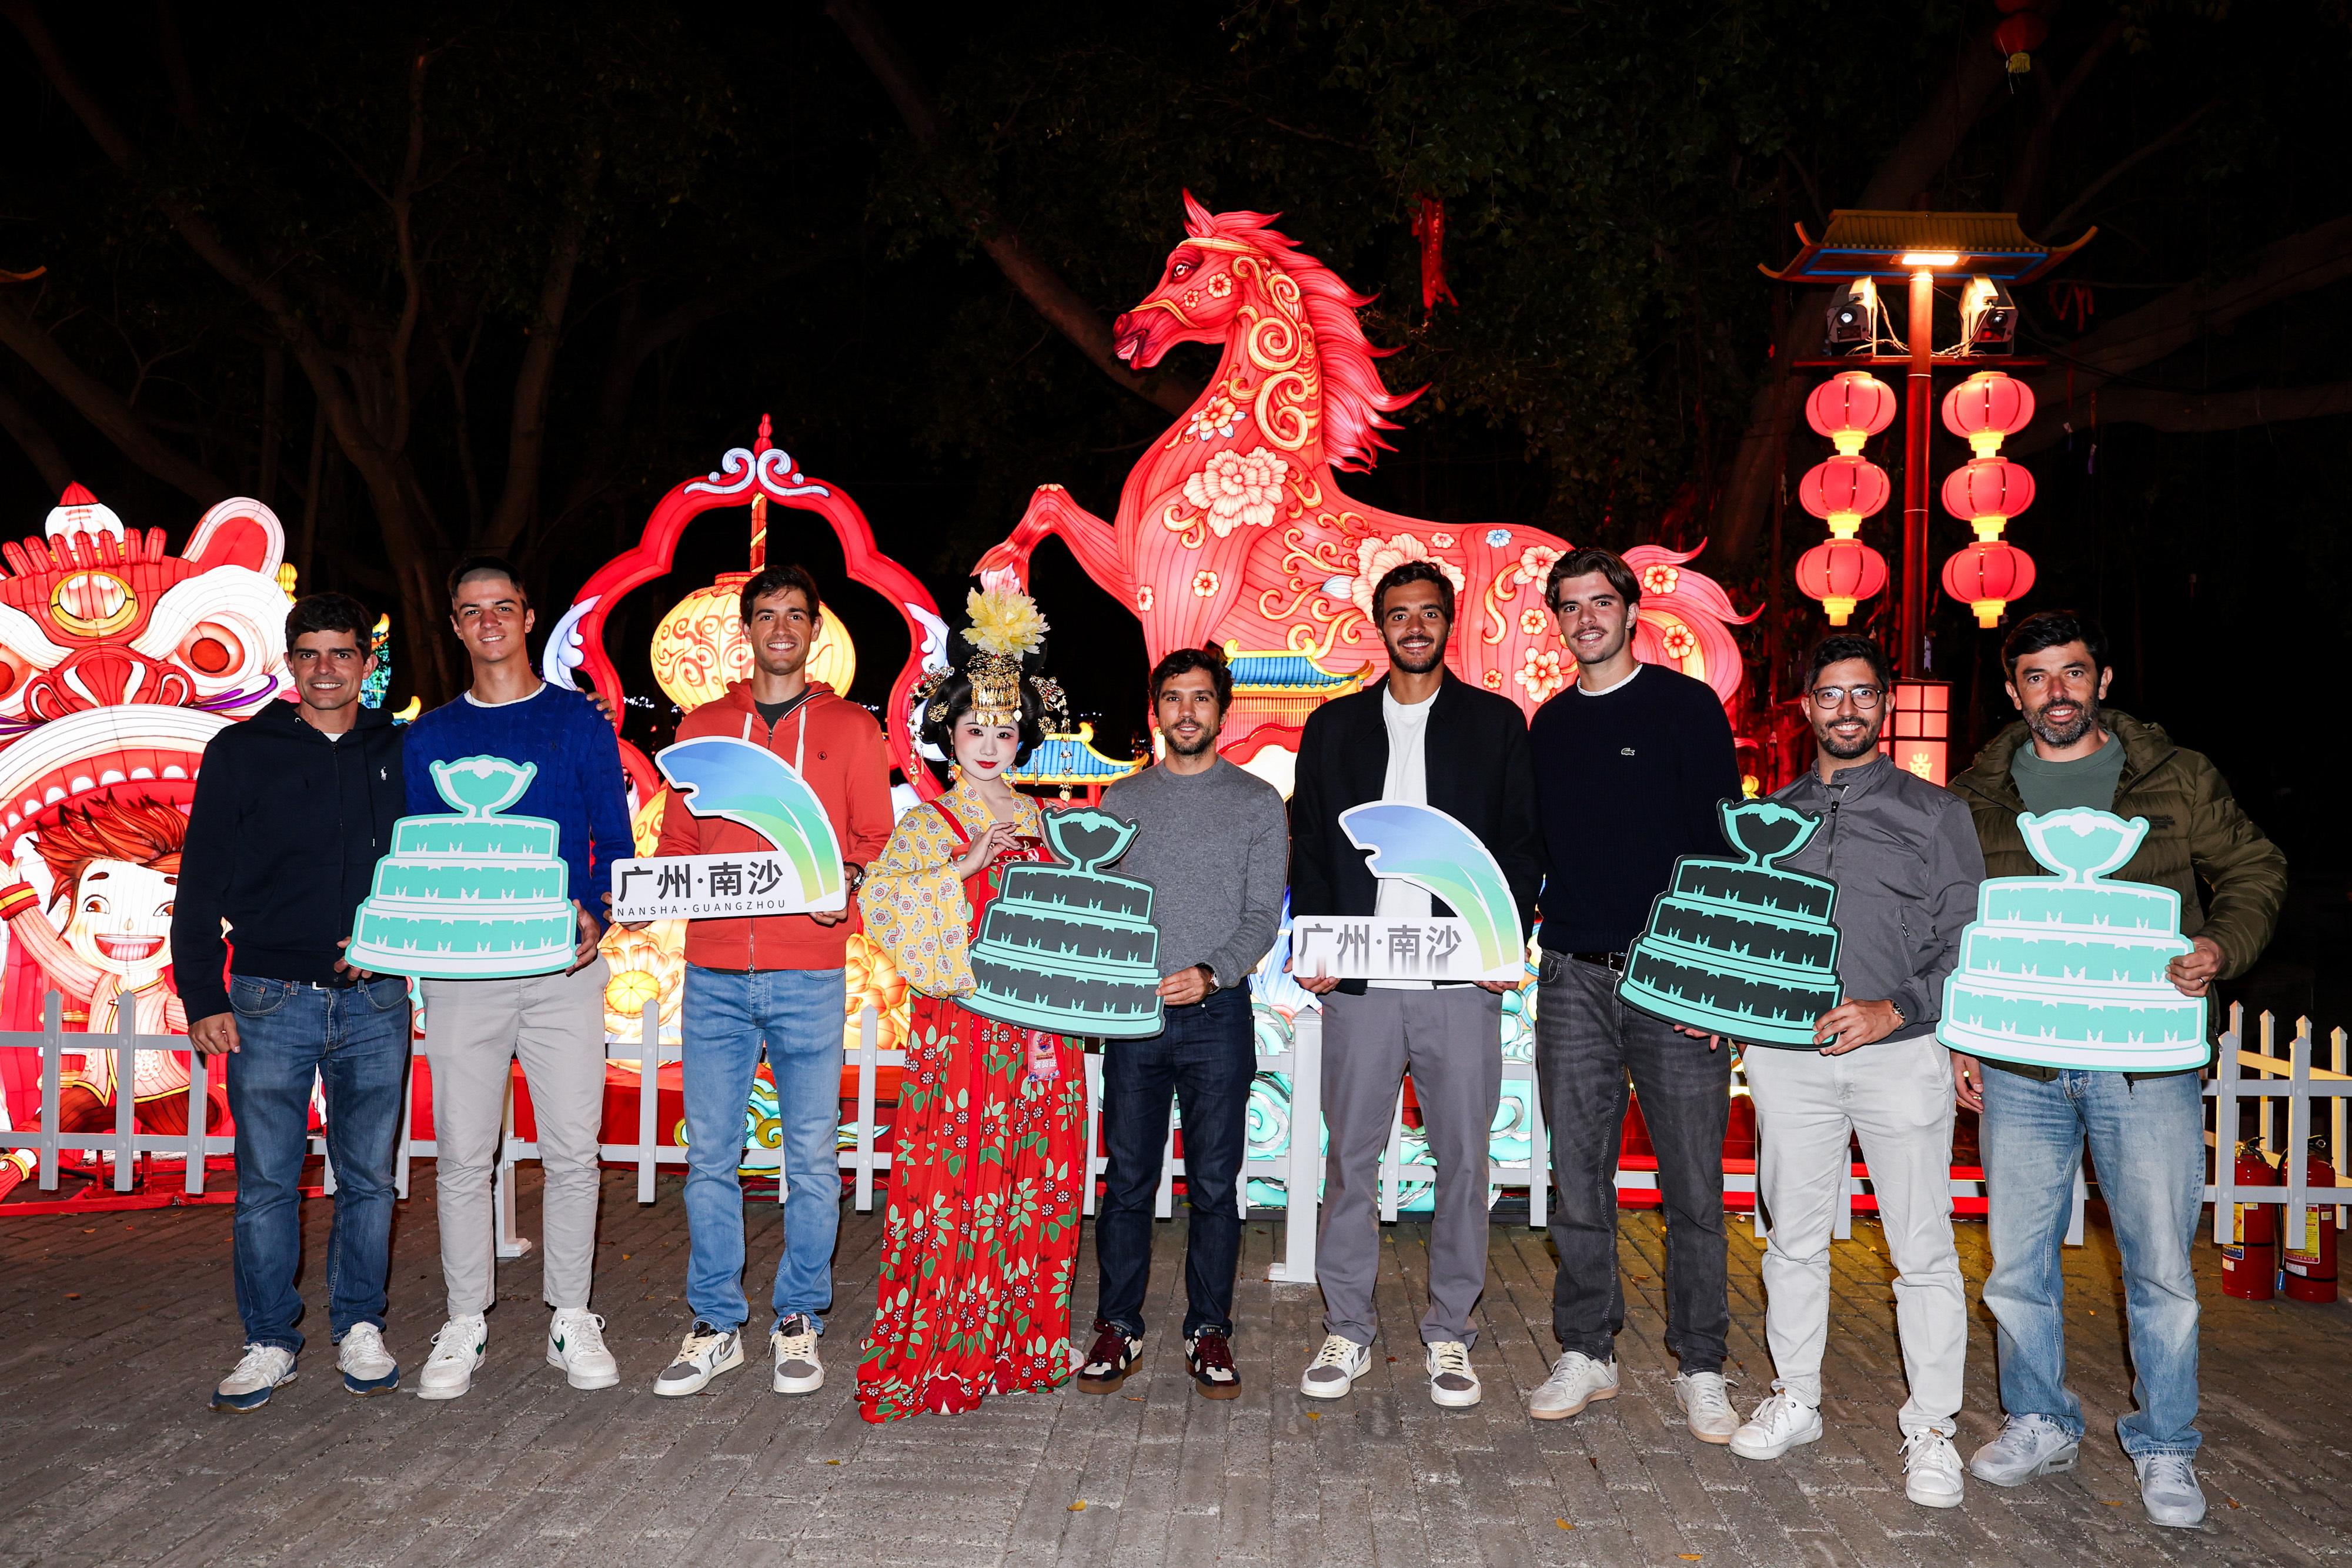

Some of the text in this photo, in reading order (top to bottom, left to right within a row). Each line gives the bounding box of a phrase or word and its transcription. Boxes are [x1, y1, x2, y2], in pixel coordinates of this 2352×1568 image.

[618, 860, 783, 902] 广州·南沙
[1298, 924, 1462, 957] 广州·南沙
[1034, 1059, 1057, 1069] 演员证
